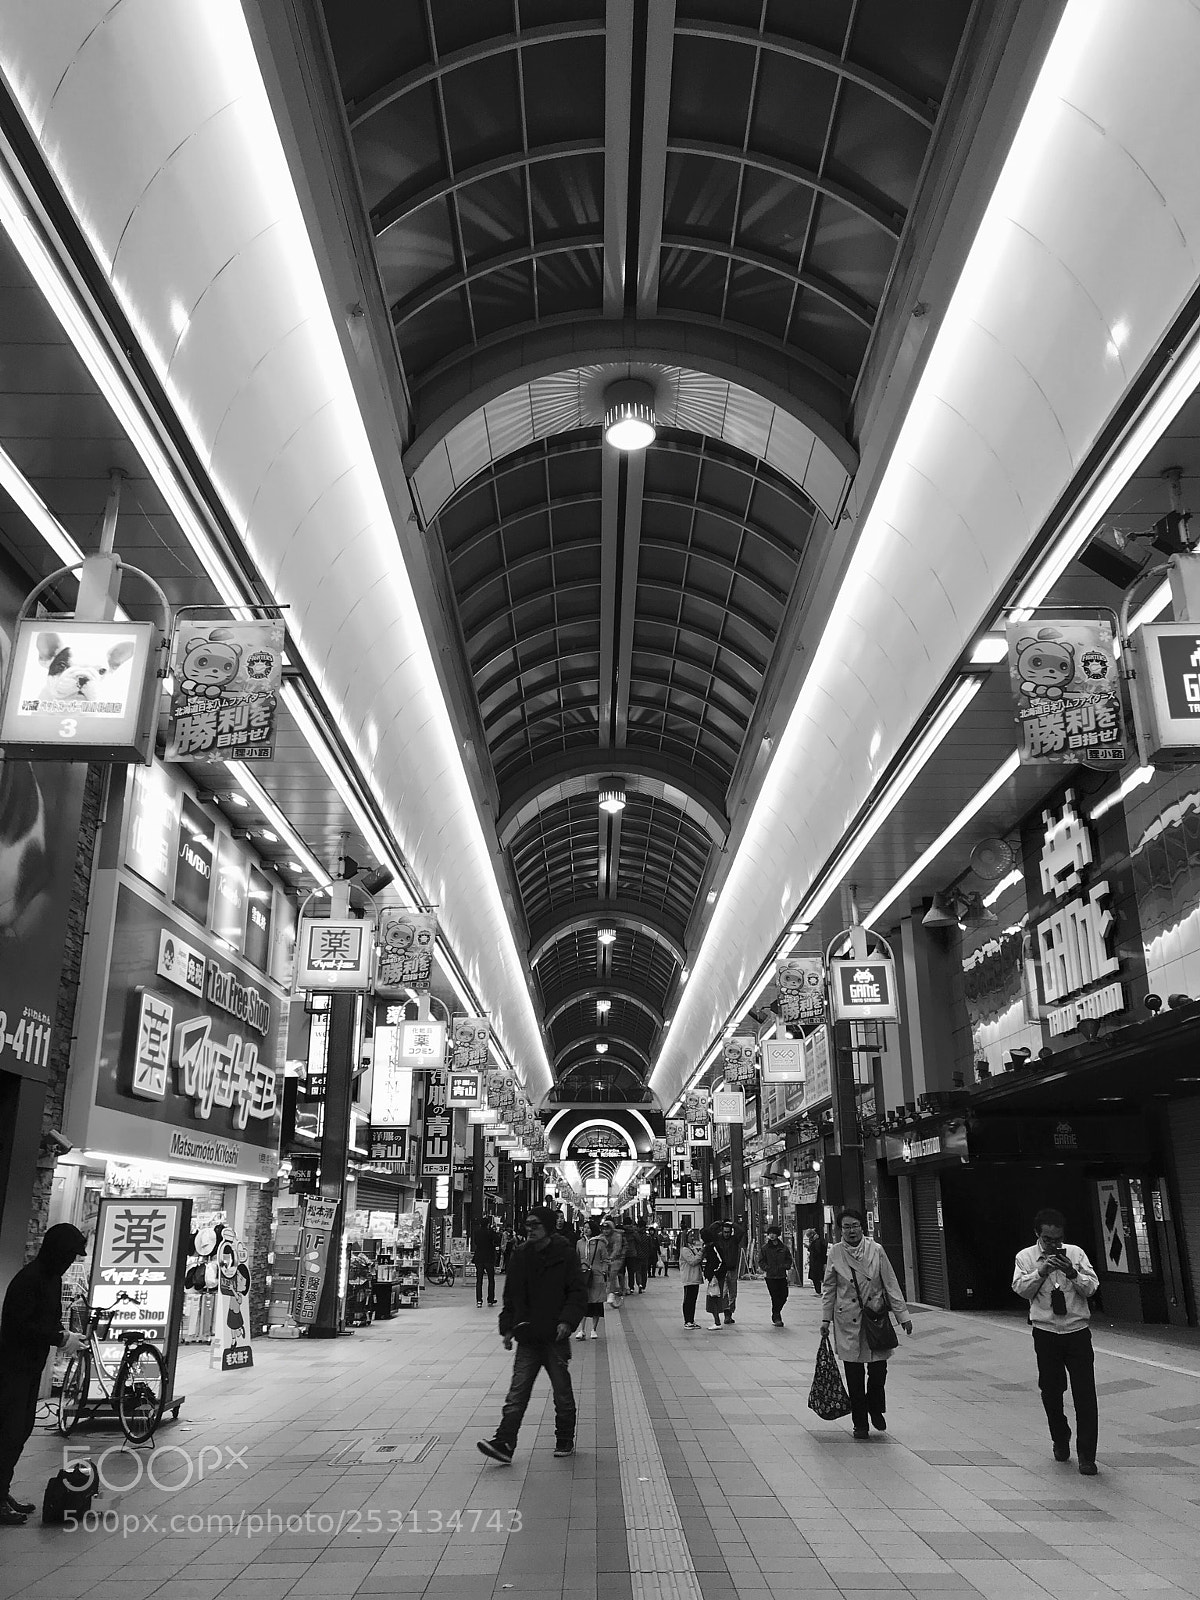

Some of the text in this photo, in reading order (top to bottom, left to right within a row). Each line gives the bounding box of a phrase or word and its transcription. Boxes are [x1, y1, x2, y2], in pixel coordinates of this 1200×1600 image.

[1182, 673, 1200, 702] G
[59, 718, 78, 738] 3
[176, 704, 271, 754] 勝利を
[1023, 706, 1116, 757] 勝利を
[320, 929, 351, 959] 薬
[1037, 880, 1120, 1004] GAME
[209, 961, 229, 1004] Tax
[230, 974, 249, 1021] Free
[248, 989, 270, 1035] Shop
[849, 983, 881, 998] GAME
[138, 1002, 170, 1089] 薬
[408, 1047, 434, 1055] コクミン
[452, 1086, 477, 1097] 青山
[170, 1133, 214, 1160] Matsumoto
[371, 1143, 402, 1158] 青山
[1053, 1133, 1078, 1145] GAME
[112, 1208, 167, 1264] 薬
[305, 1234, 325, 1250] 1F
[114, 1309, 137, 1320] Free
[139, 1309, 165, 1321] Shop
